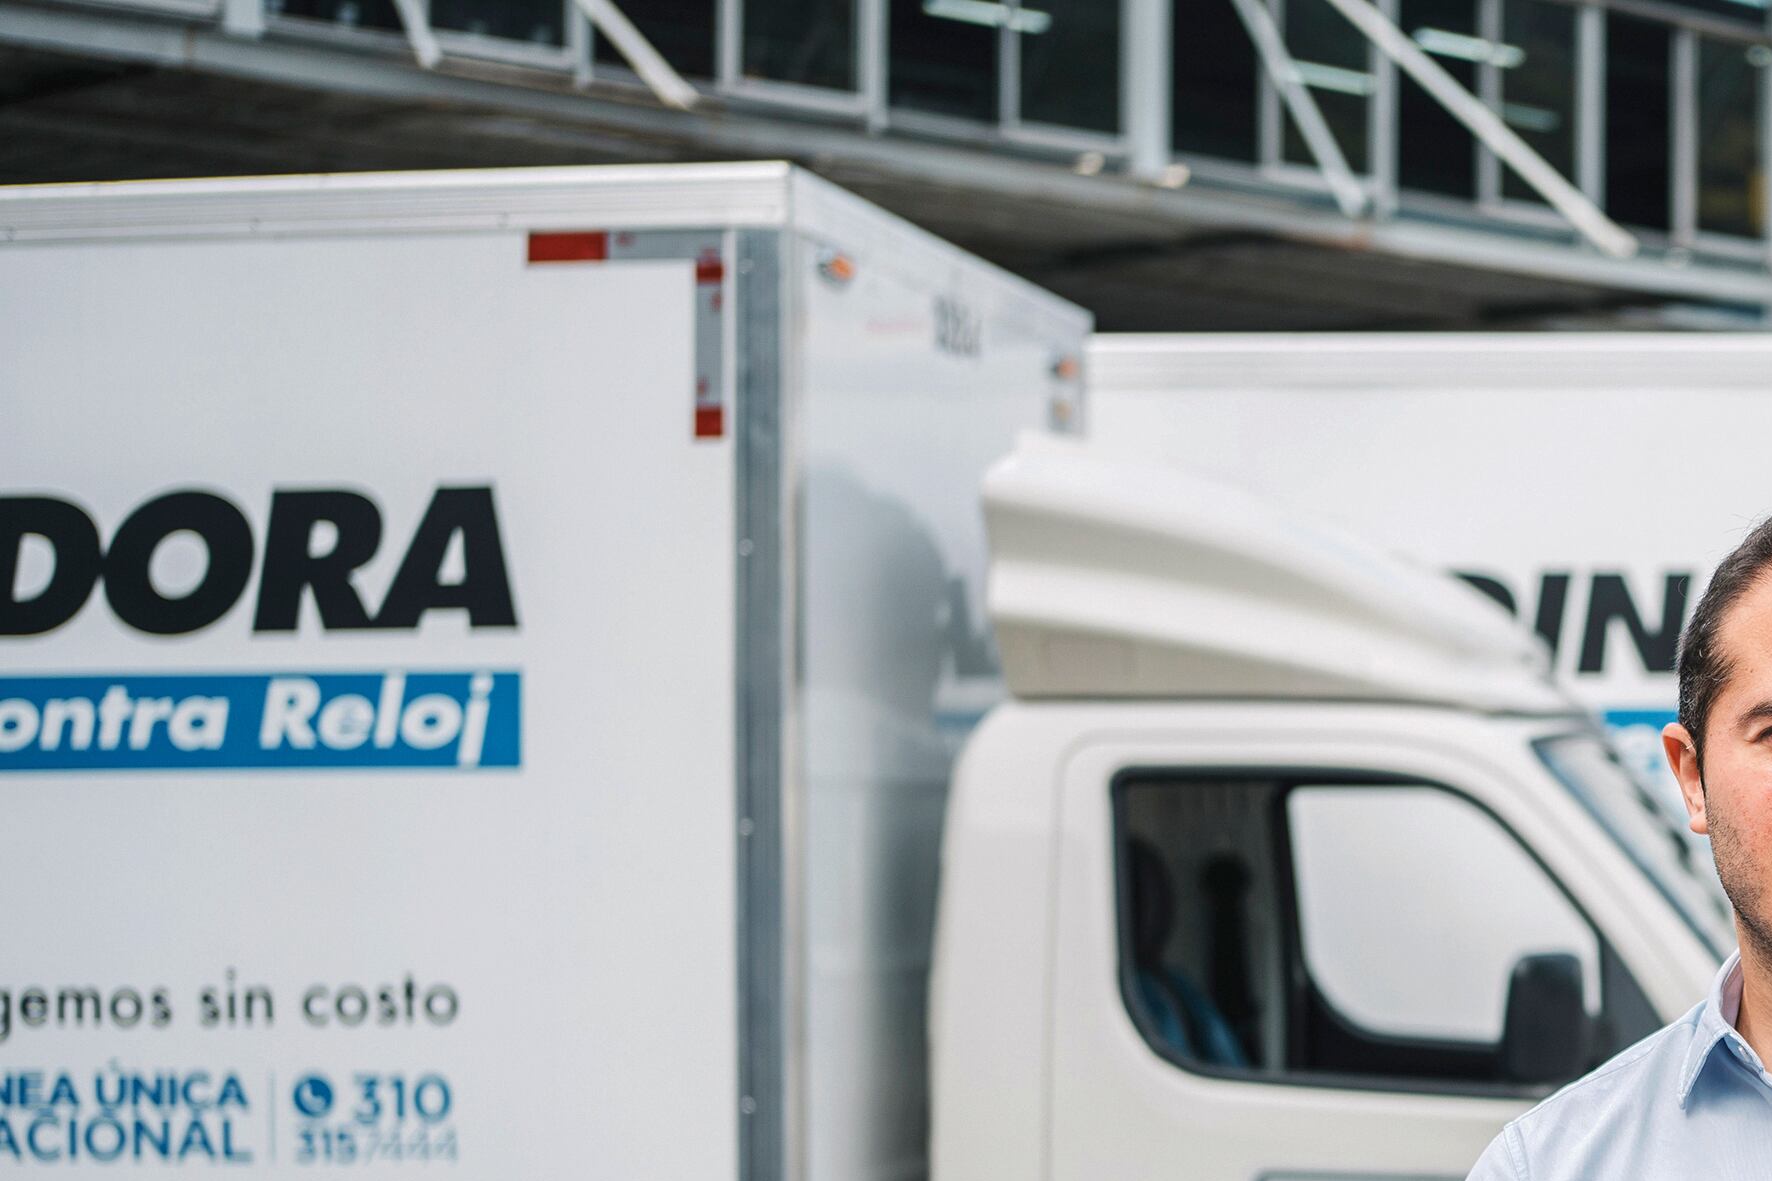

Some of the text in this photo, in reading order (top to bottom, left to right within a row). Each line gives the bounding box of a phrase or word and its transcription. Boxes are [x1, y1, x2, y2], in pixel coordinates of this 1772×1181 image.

[259, 673, 494, 768] Reloj
[200, 967, 274, 1027] sin
[302, 971, 460, 1028] costo
[353, 1073, 452, 1124] 310
